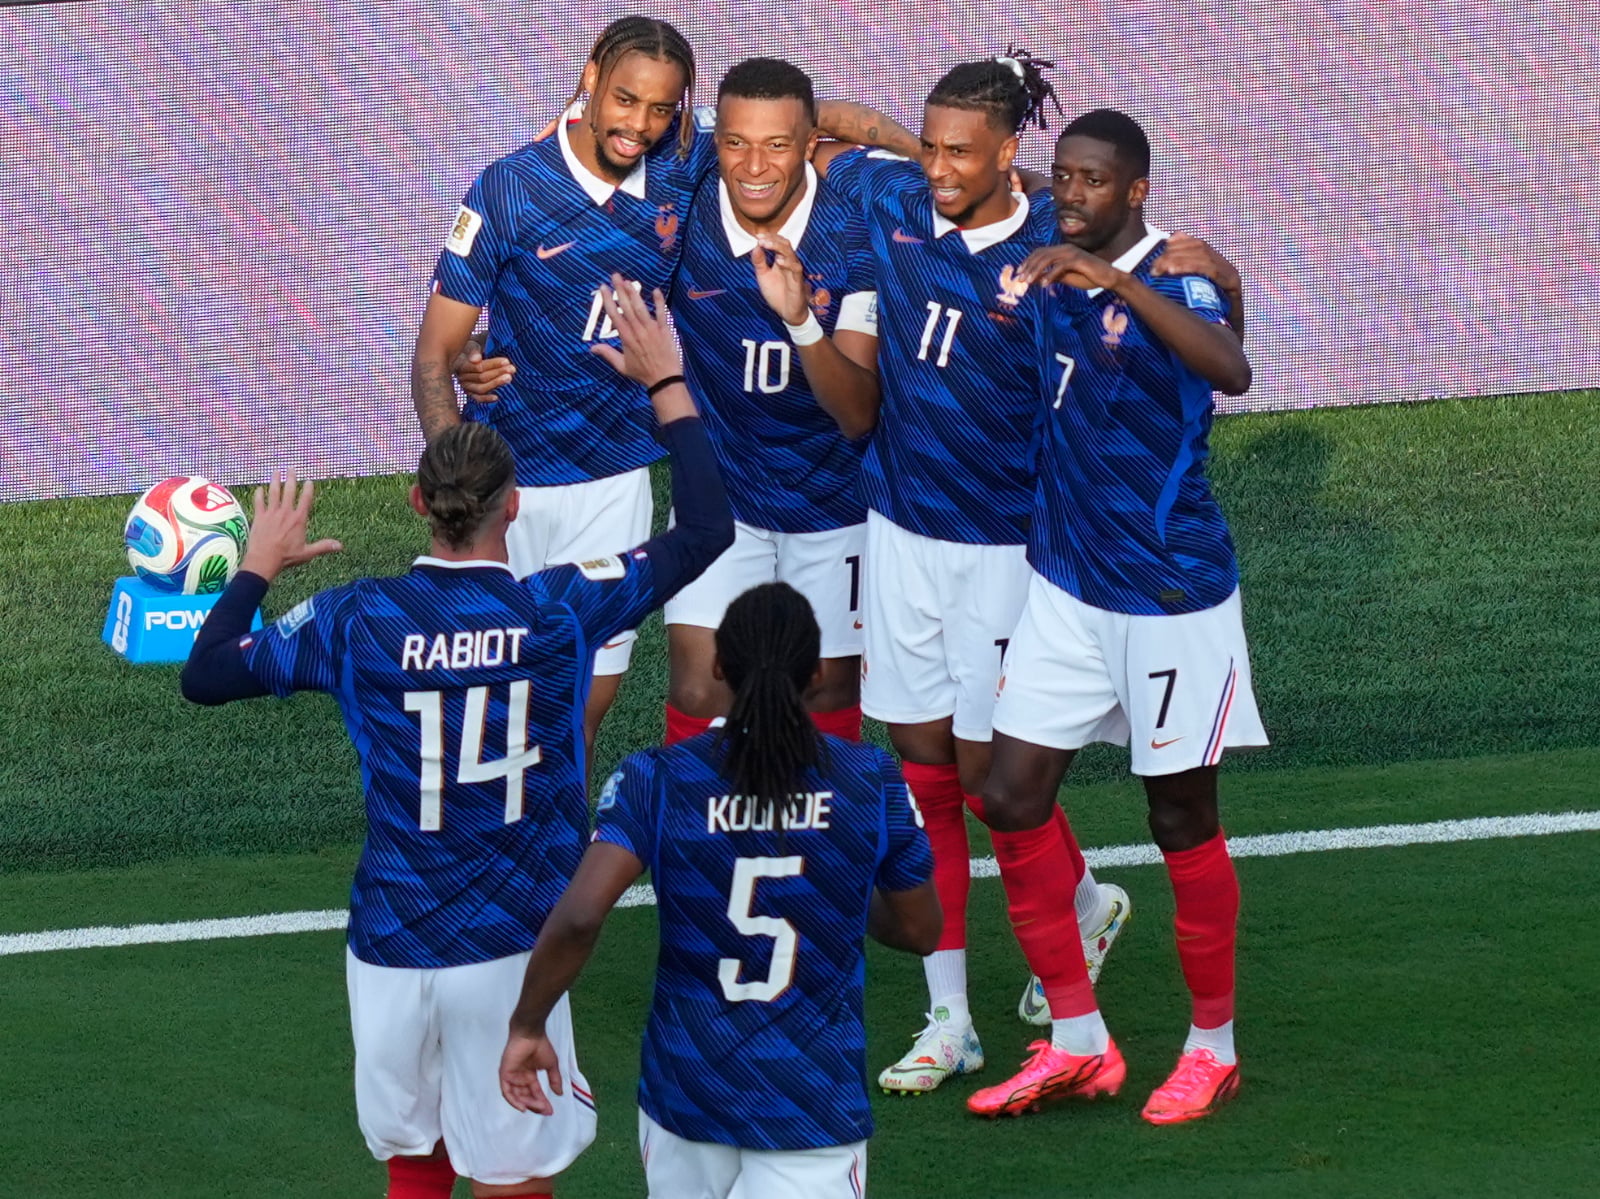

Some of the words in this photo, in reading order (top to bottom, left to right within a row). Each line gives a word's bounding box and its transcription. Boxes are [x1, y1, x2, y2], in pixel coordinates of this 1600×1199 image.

[582, 281, 642, 341] 1
[917, 301, 963, 368] 11
[741, 338, 791, 395] 10
[1053, 352, 1075, 410] 7
[845, 554, 861, 612] 1
[402, 627, 528, 671] RABIOT
[1148, 668, 1177, 729] 7
[404, 680, 543, 832] 14
[718, 855, 804, 1003] 5
